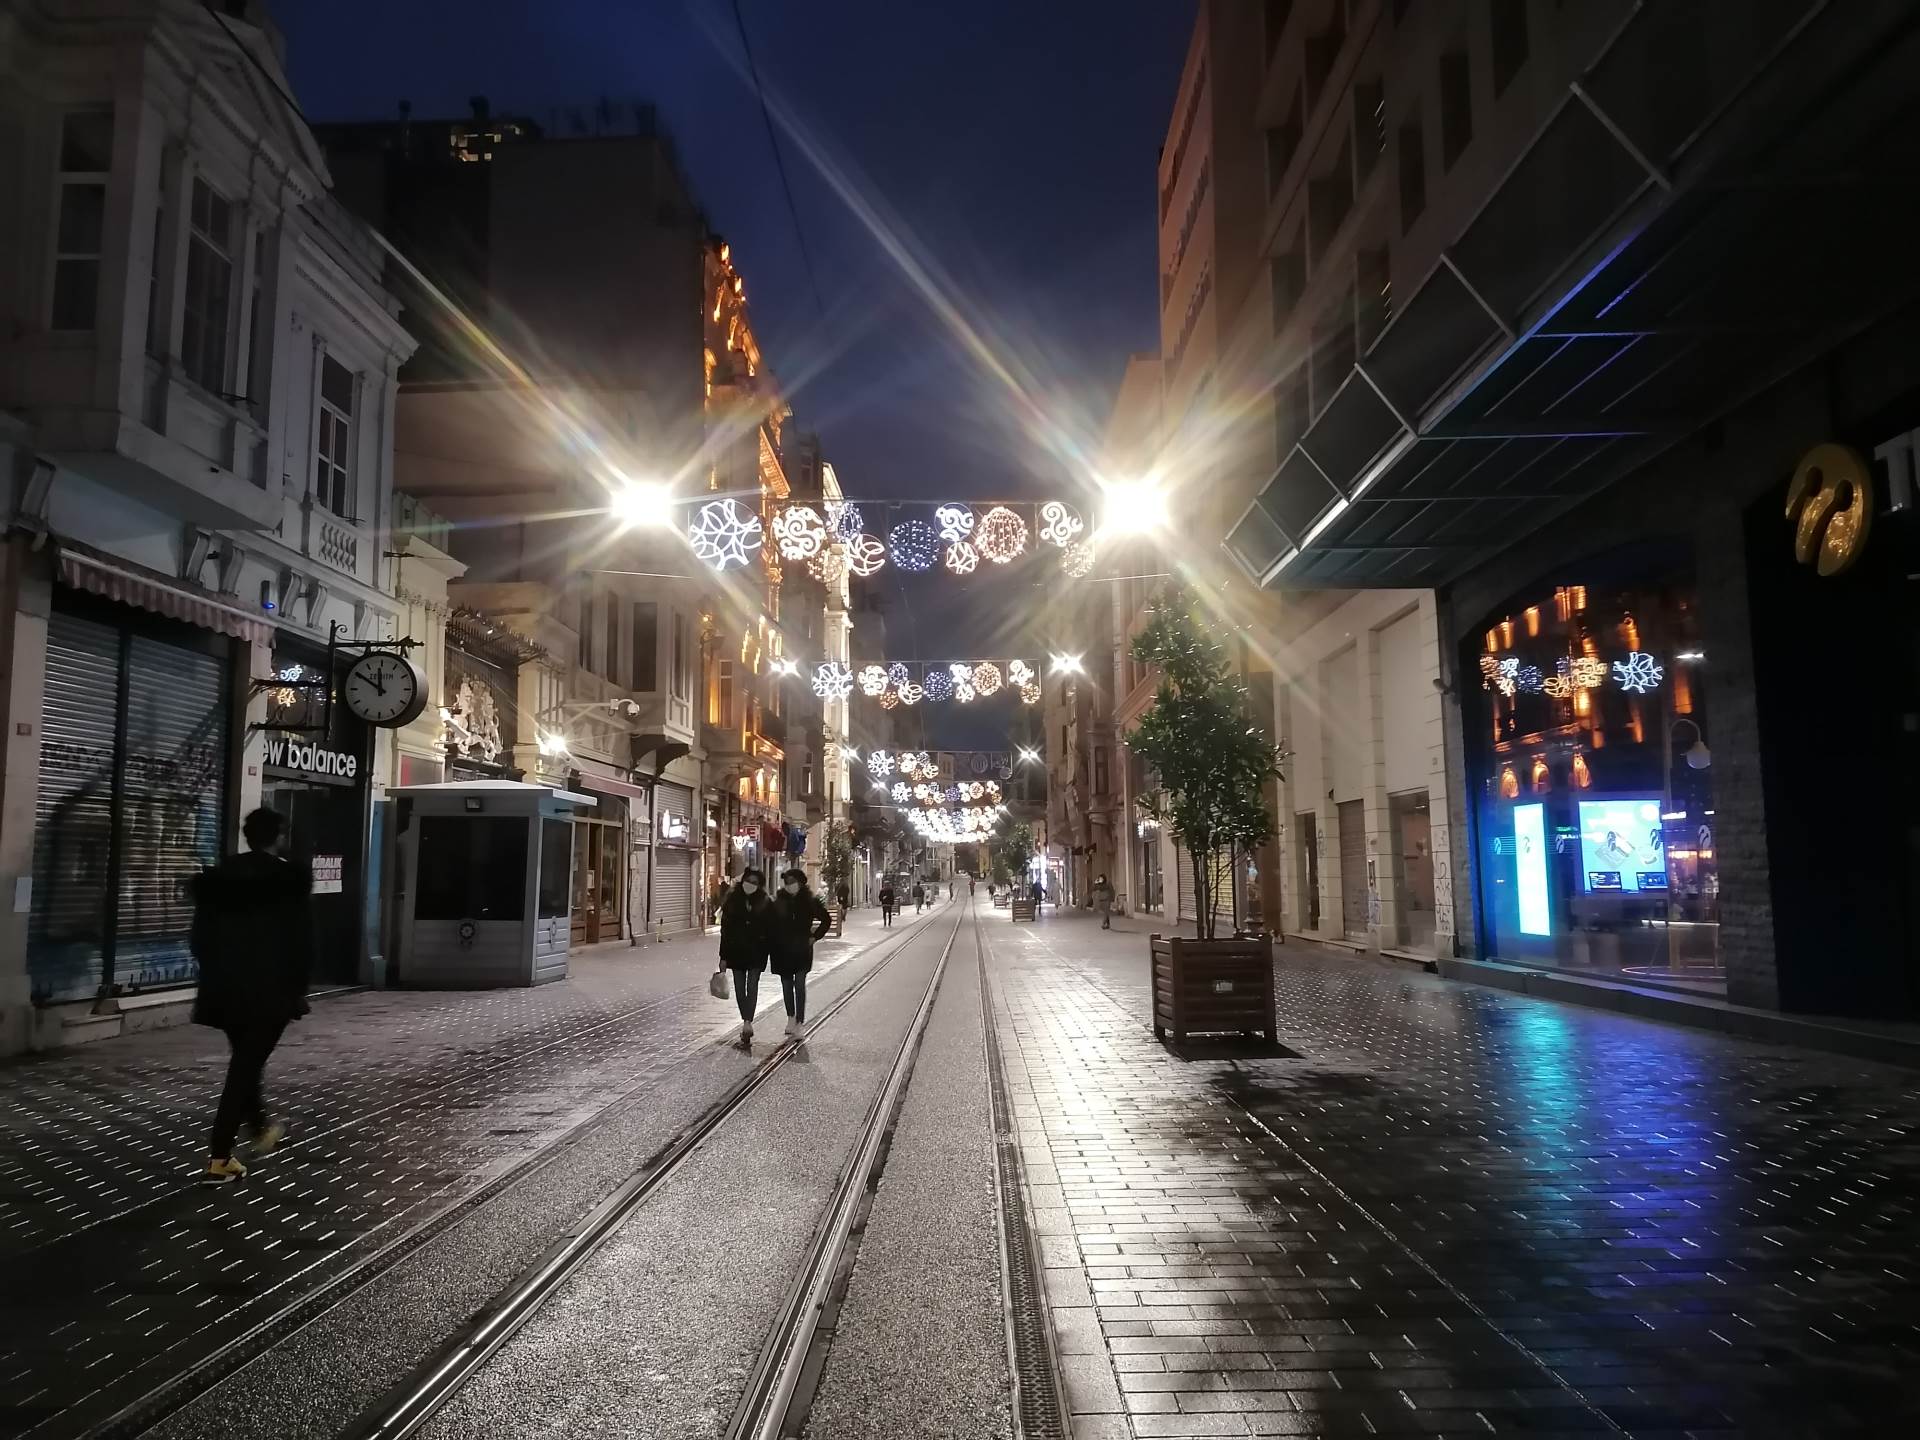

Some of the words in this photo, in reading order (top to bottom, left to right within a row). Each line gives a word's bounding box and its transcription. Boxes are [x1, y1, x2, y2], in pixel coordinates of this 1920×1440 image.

[369, 673, 394, 681] ZEITH
[263, 739, 285, 766] ew
[288, 737, 357, 777] balance
